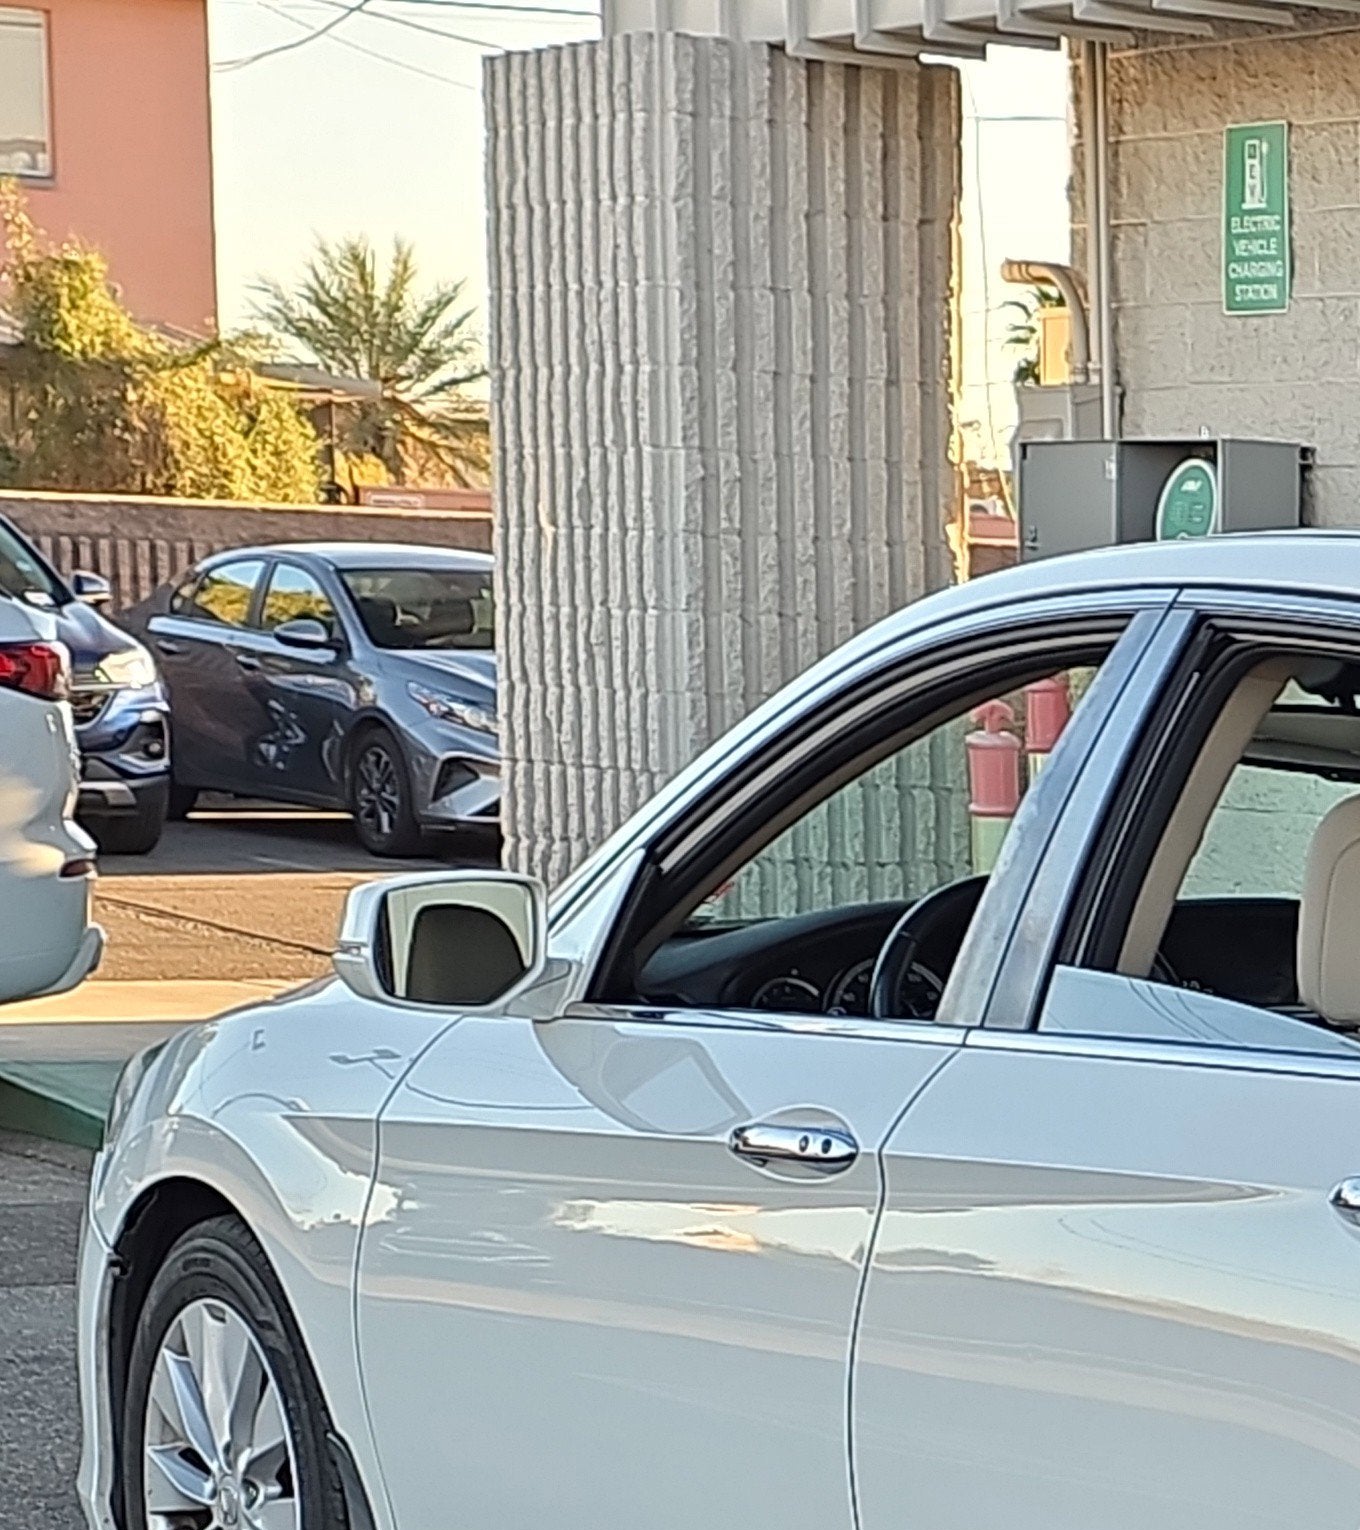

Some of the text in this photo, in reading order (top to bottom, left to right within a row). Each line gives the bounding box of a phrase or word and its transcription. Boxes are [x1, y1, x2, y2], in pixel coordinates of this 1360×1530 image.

[1231, 215, 1281, 235] ELECTRIC
[1234, 238, 1278, 256] VEHICLE
[1228, 260, 1284, 279] CHARGING
[1235, 283, 1278, 302] STATION
